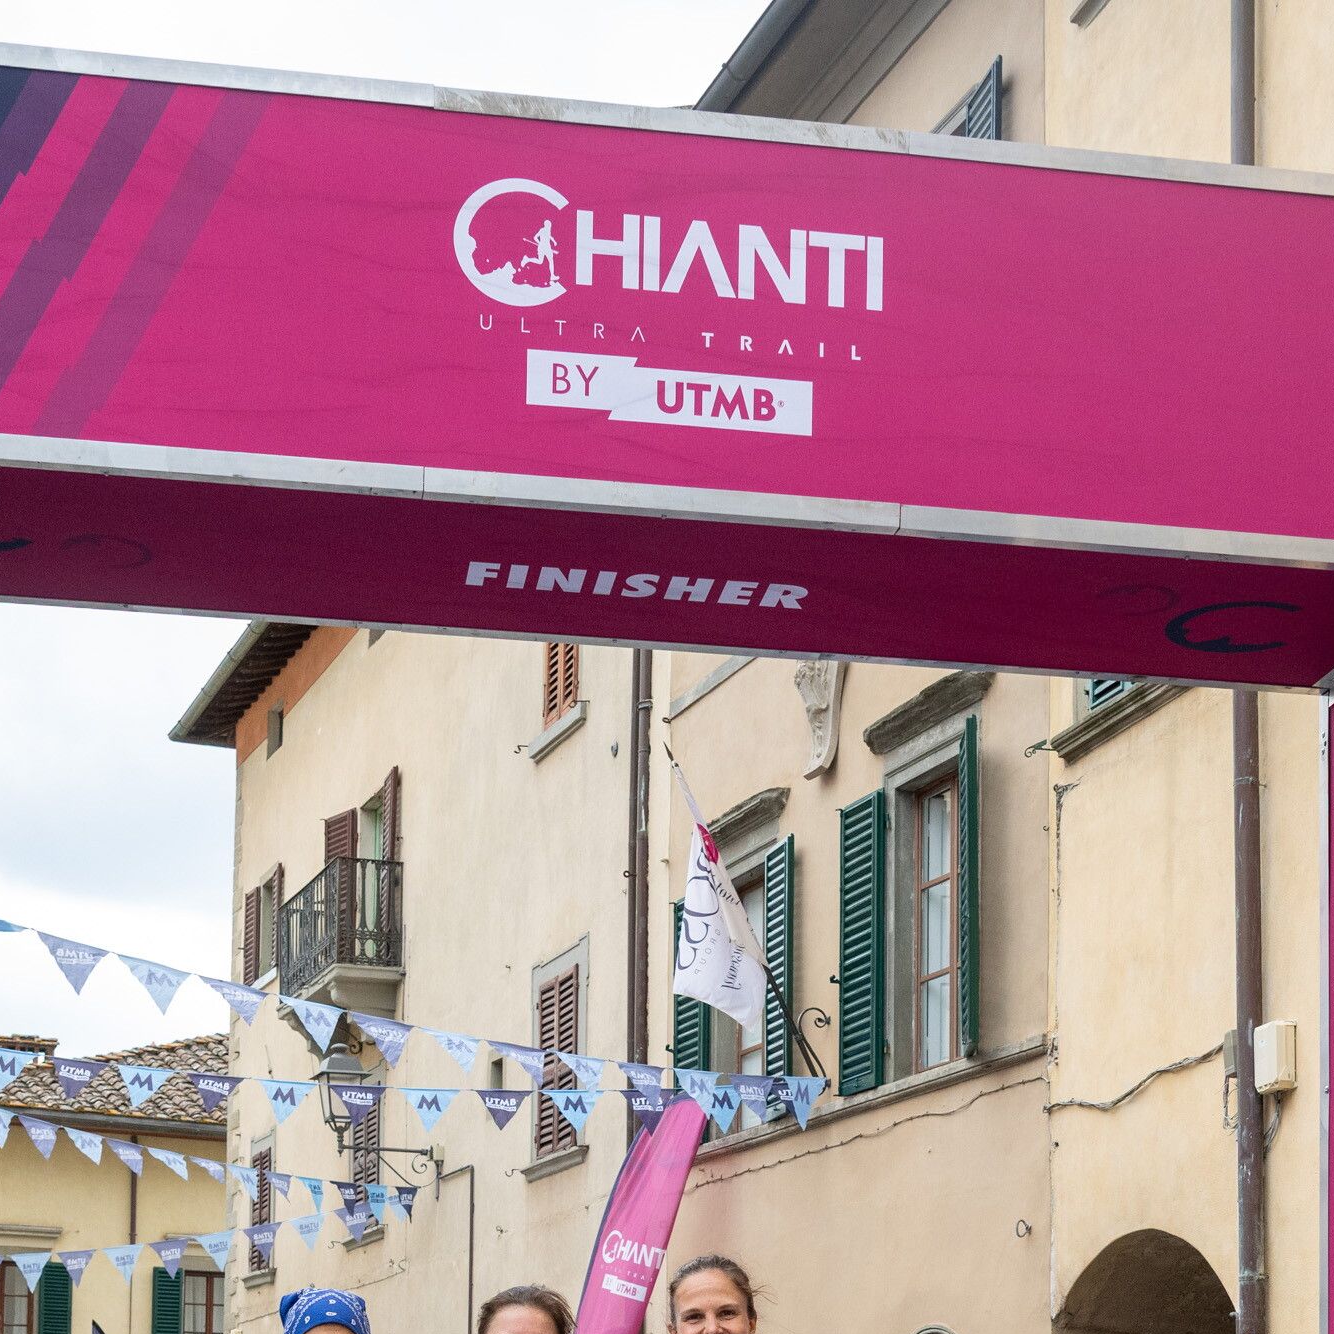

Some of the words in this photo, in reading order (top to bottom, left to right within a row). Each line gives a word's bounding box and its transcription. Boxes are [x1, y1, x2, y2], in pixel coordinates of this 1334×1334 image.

[453, 178, 883, 311] CHIANTI
[479, 314, 645, 342] ULTRA
[701, 332, 861, 361] TRAIL
[552, 364, 599, 397] BY
[465, 561, 808, 609] FINISHER
[602, 1230, 666, 1270] CHIANT
